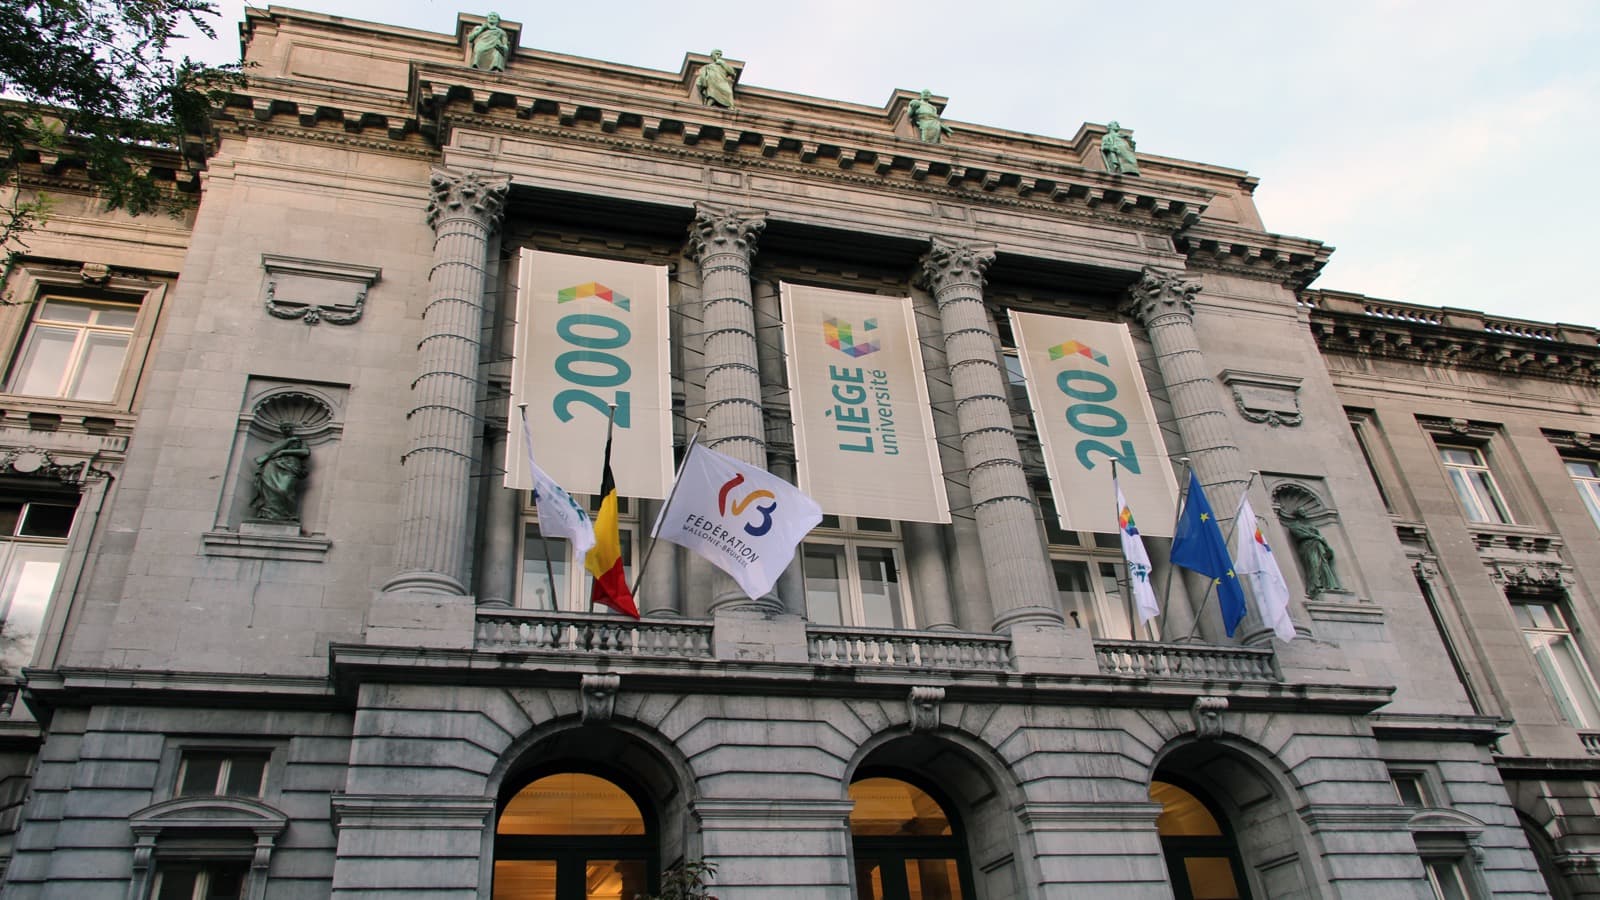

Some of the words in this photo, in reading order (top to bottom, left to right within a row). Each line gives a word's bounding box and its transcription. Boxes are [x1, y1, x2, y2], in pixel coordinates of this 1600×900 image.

[553, 314, 632, 429] 200
[825, 365, 875, 453] LIÈGE
[868, 369, 900, 455] université
[1057, 370, 1141, 475] 200
[686, 514, 760, 563] FÉDÉRATION
